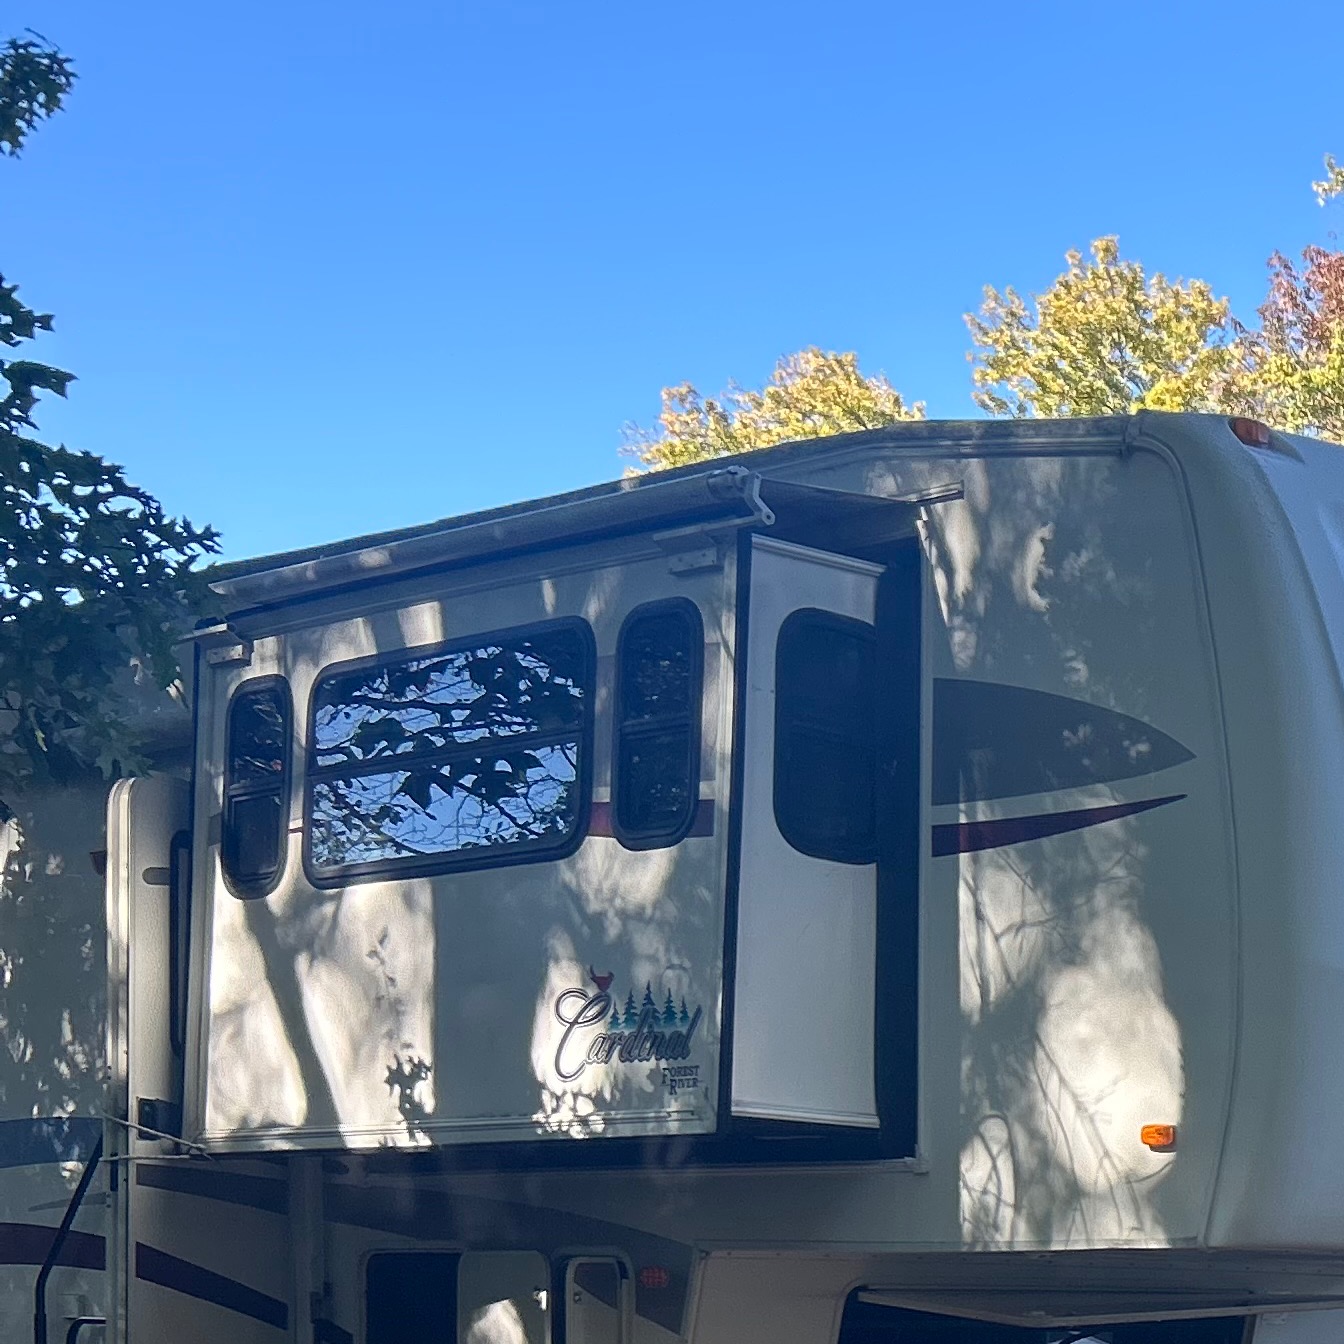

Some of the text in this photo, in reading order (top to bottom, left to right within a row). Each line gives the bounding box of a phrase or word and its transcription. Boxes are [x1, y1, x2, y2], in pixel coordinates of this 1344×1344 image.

[555, 988, 702, 1082] Cardinal
[662, 1065, 699, 1084] FOREST
[669, 1078, 699, 1095] RIVER
